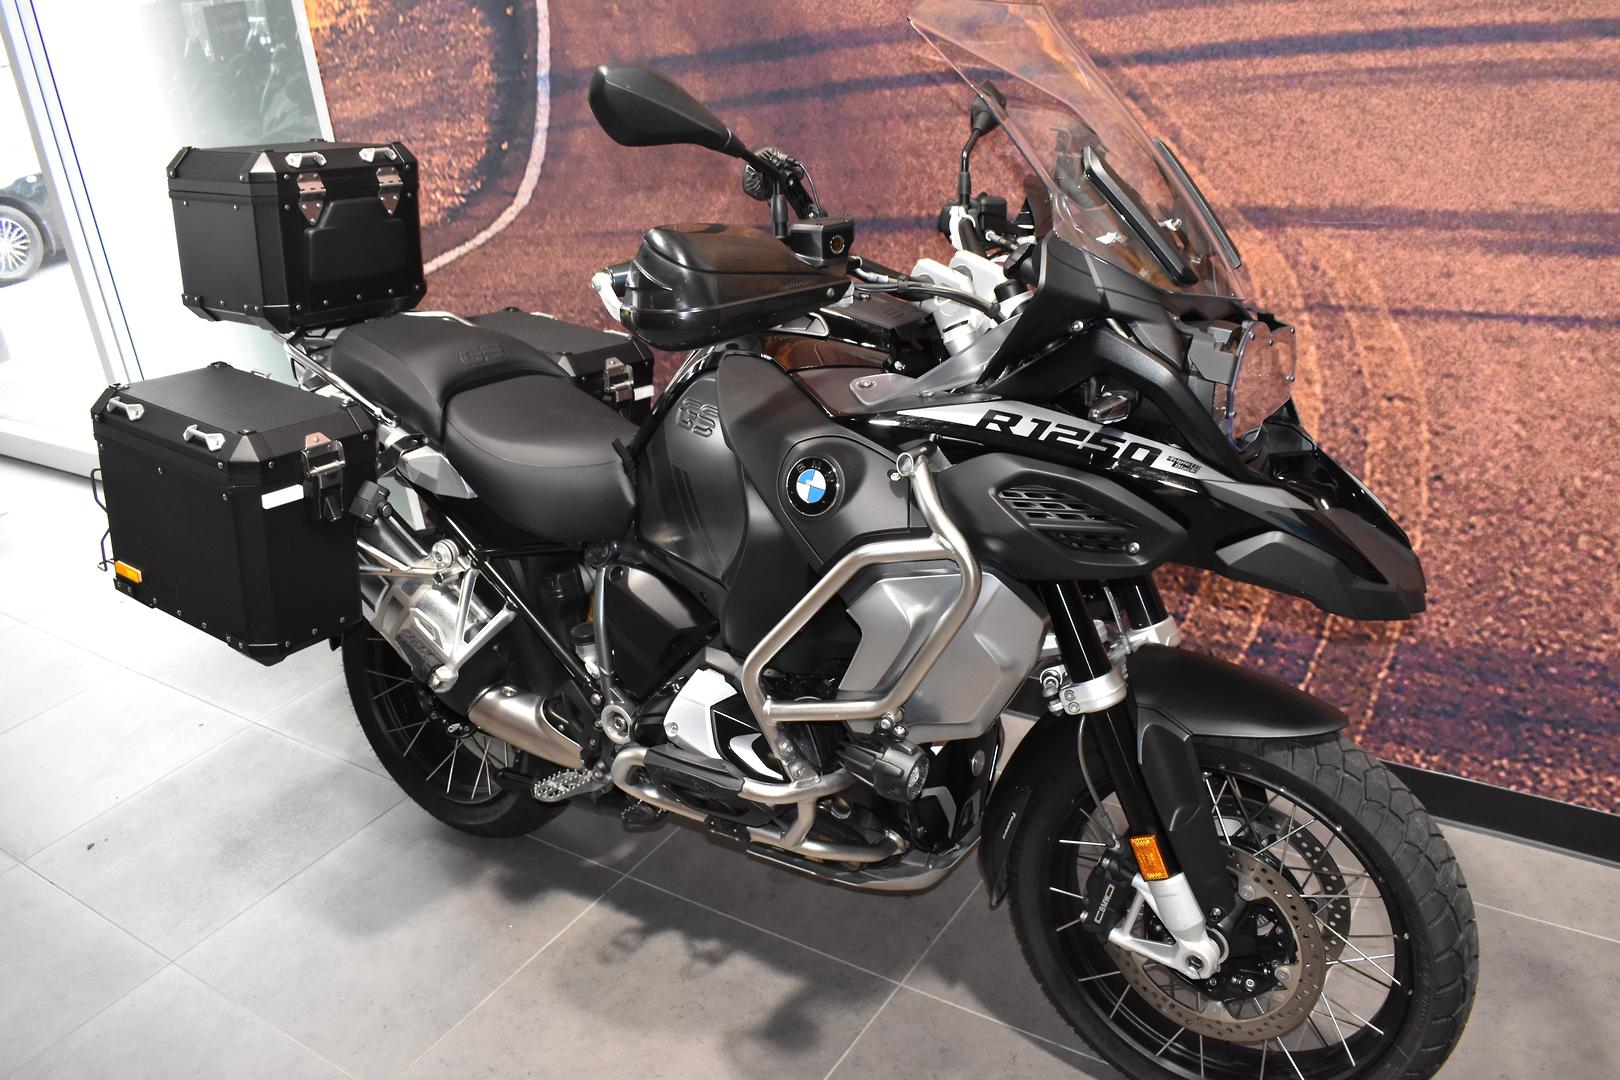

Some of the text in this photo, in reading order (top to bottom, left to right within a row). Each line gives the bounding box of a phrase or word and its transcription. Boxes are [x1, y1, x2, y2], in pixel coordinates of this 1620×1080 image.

[676, 397, 719, 438] GS
[974, 408, 1163, 468] R1250
[796, 459, 834, 483] BMW
